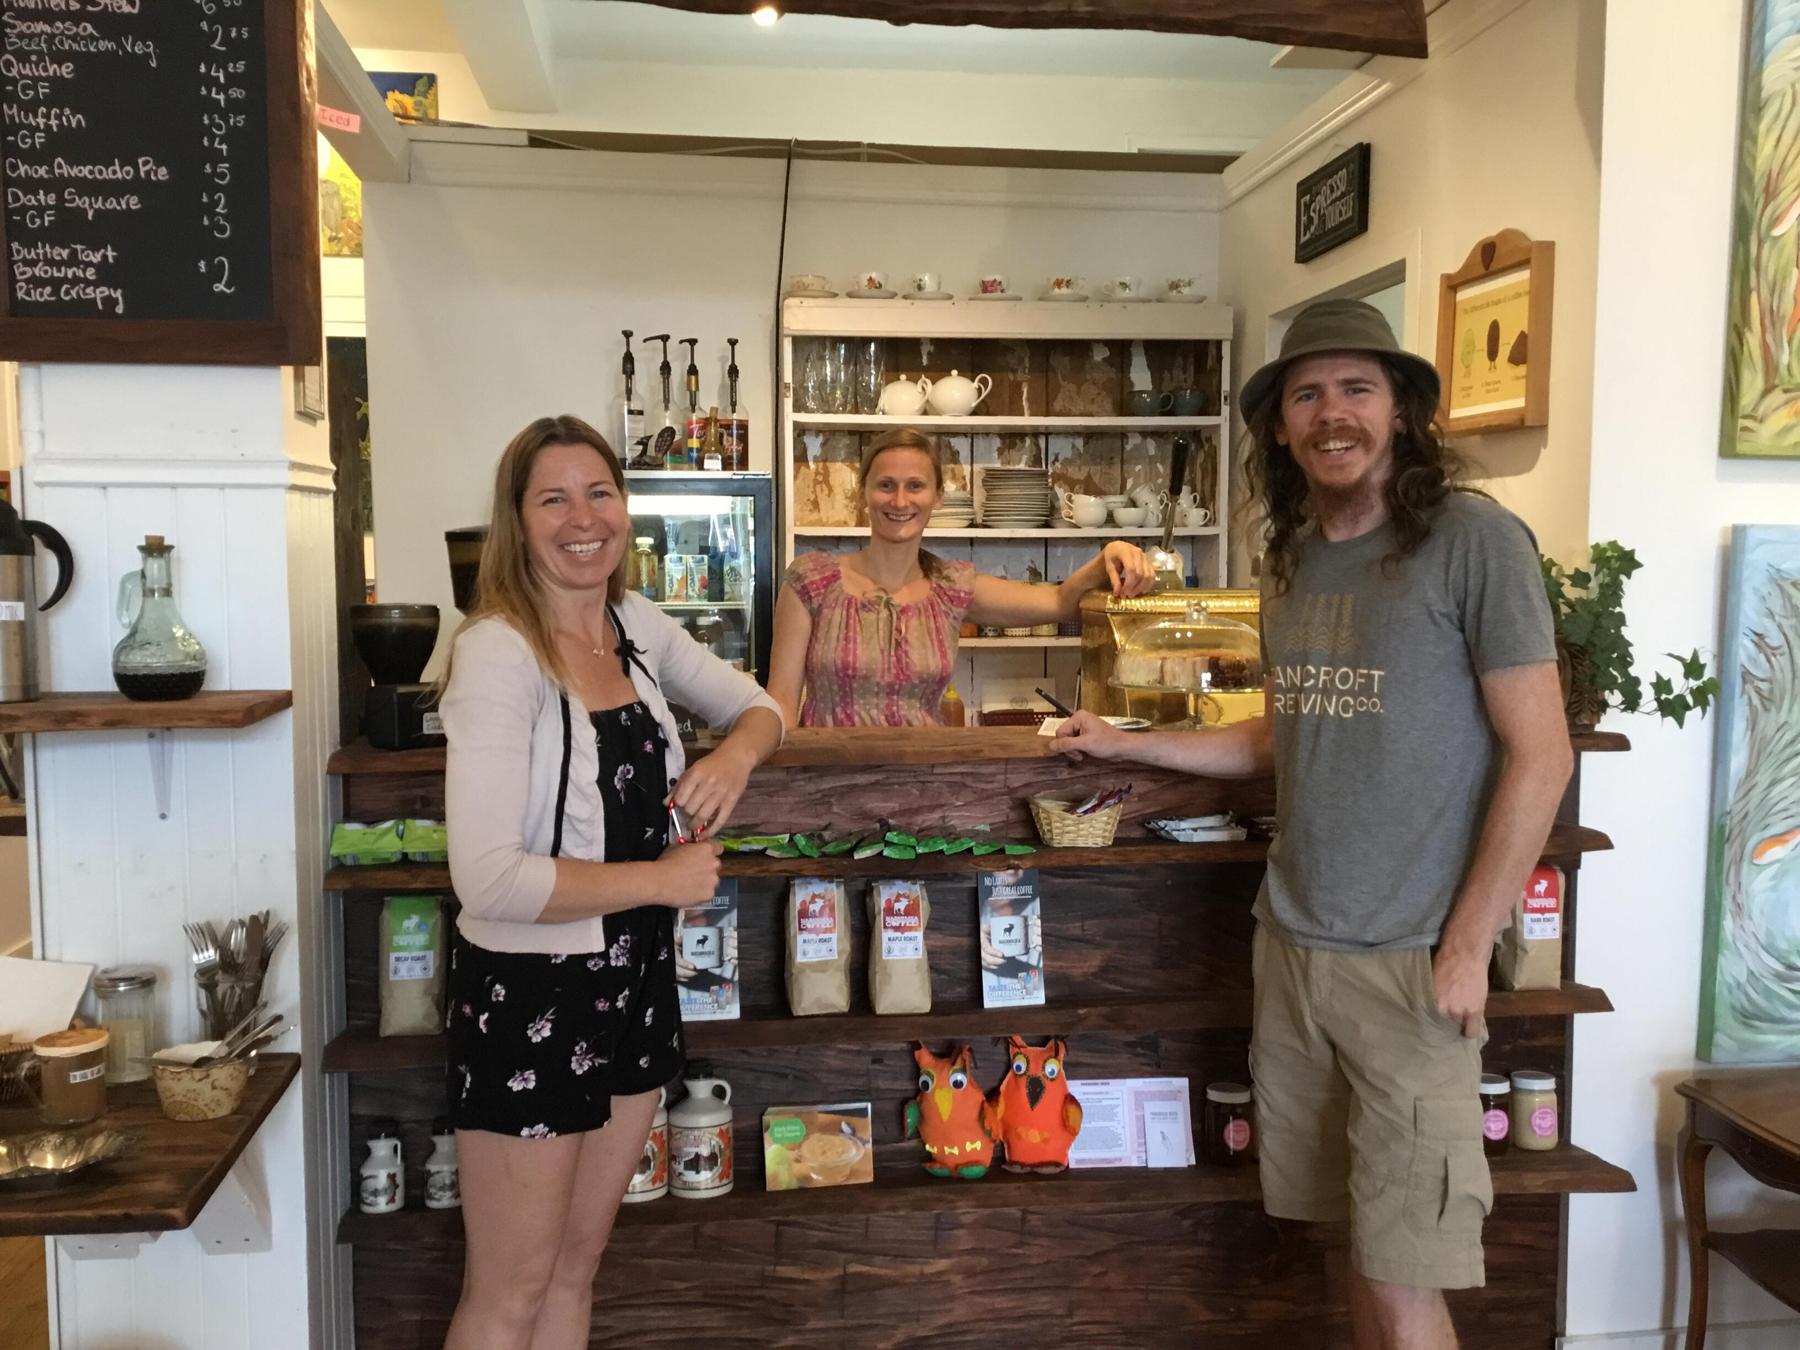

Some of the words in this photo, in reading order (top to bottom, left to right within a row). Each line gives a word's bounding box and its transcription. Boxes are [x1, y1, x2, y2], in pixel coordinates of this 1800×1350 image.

[2, 12, 99, 36] Samosa
[0, 54, 75, 78] Quiche
[3, 103, 86, 132] Muffin
[320, 108, 351, 127] Iced
[54, 157, 134, 180] Avocado
[138, 156, 169, 181] Pie
[8, 188, 56, 208] Date
[64, 188, 142, 220] Square
[11, 241, 70, 261] Butter
[71, 243, 118, 263] Tart
[13, 262, 97, 280] Brownie
[16, 282, 56, 302] Rice
[1273, 664, 1385, 693] ANCROFT
